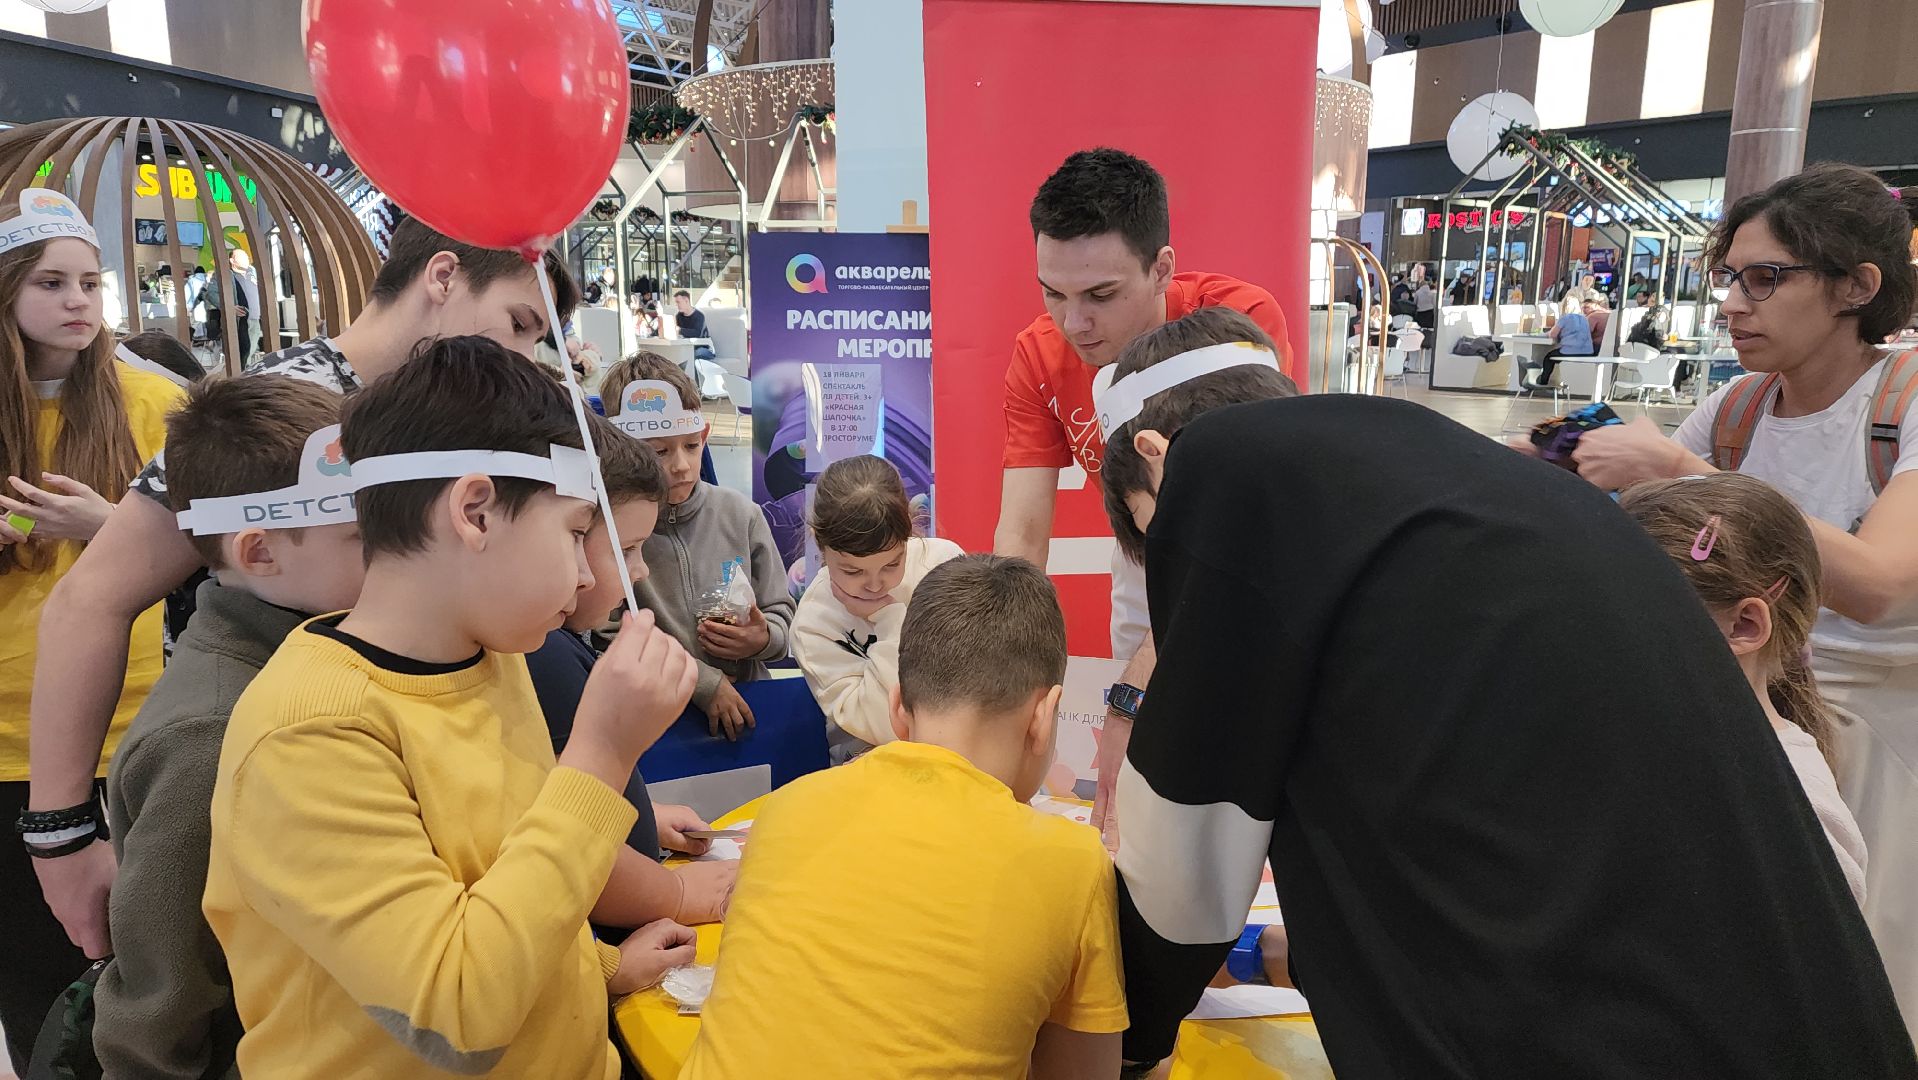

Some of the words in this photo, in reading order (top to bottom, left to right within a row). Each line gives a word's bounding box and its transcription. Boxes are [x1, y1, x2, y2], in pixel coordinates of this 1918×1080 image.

[834, 265, 932, 282] акварель
[786, 309, 932, 331] РАСПИСАНИ
[838, 424, 858, 432] 17:00
